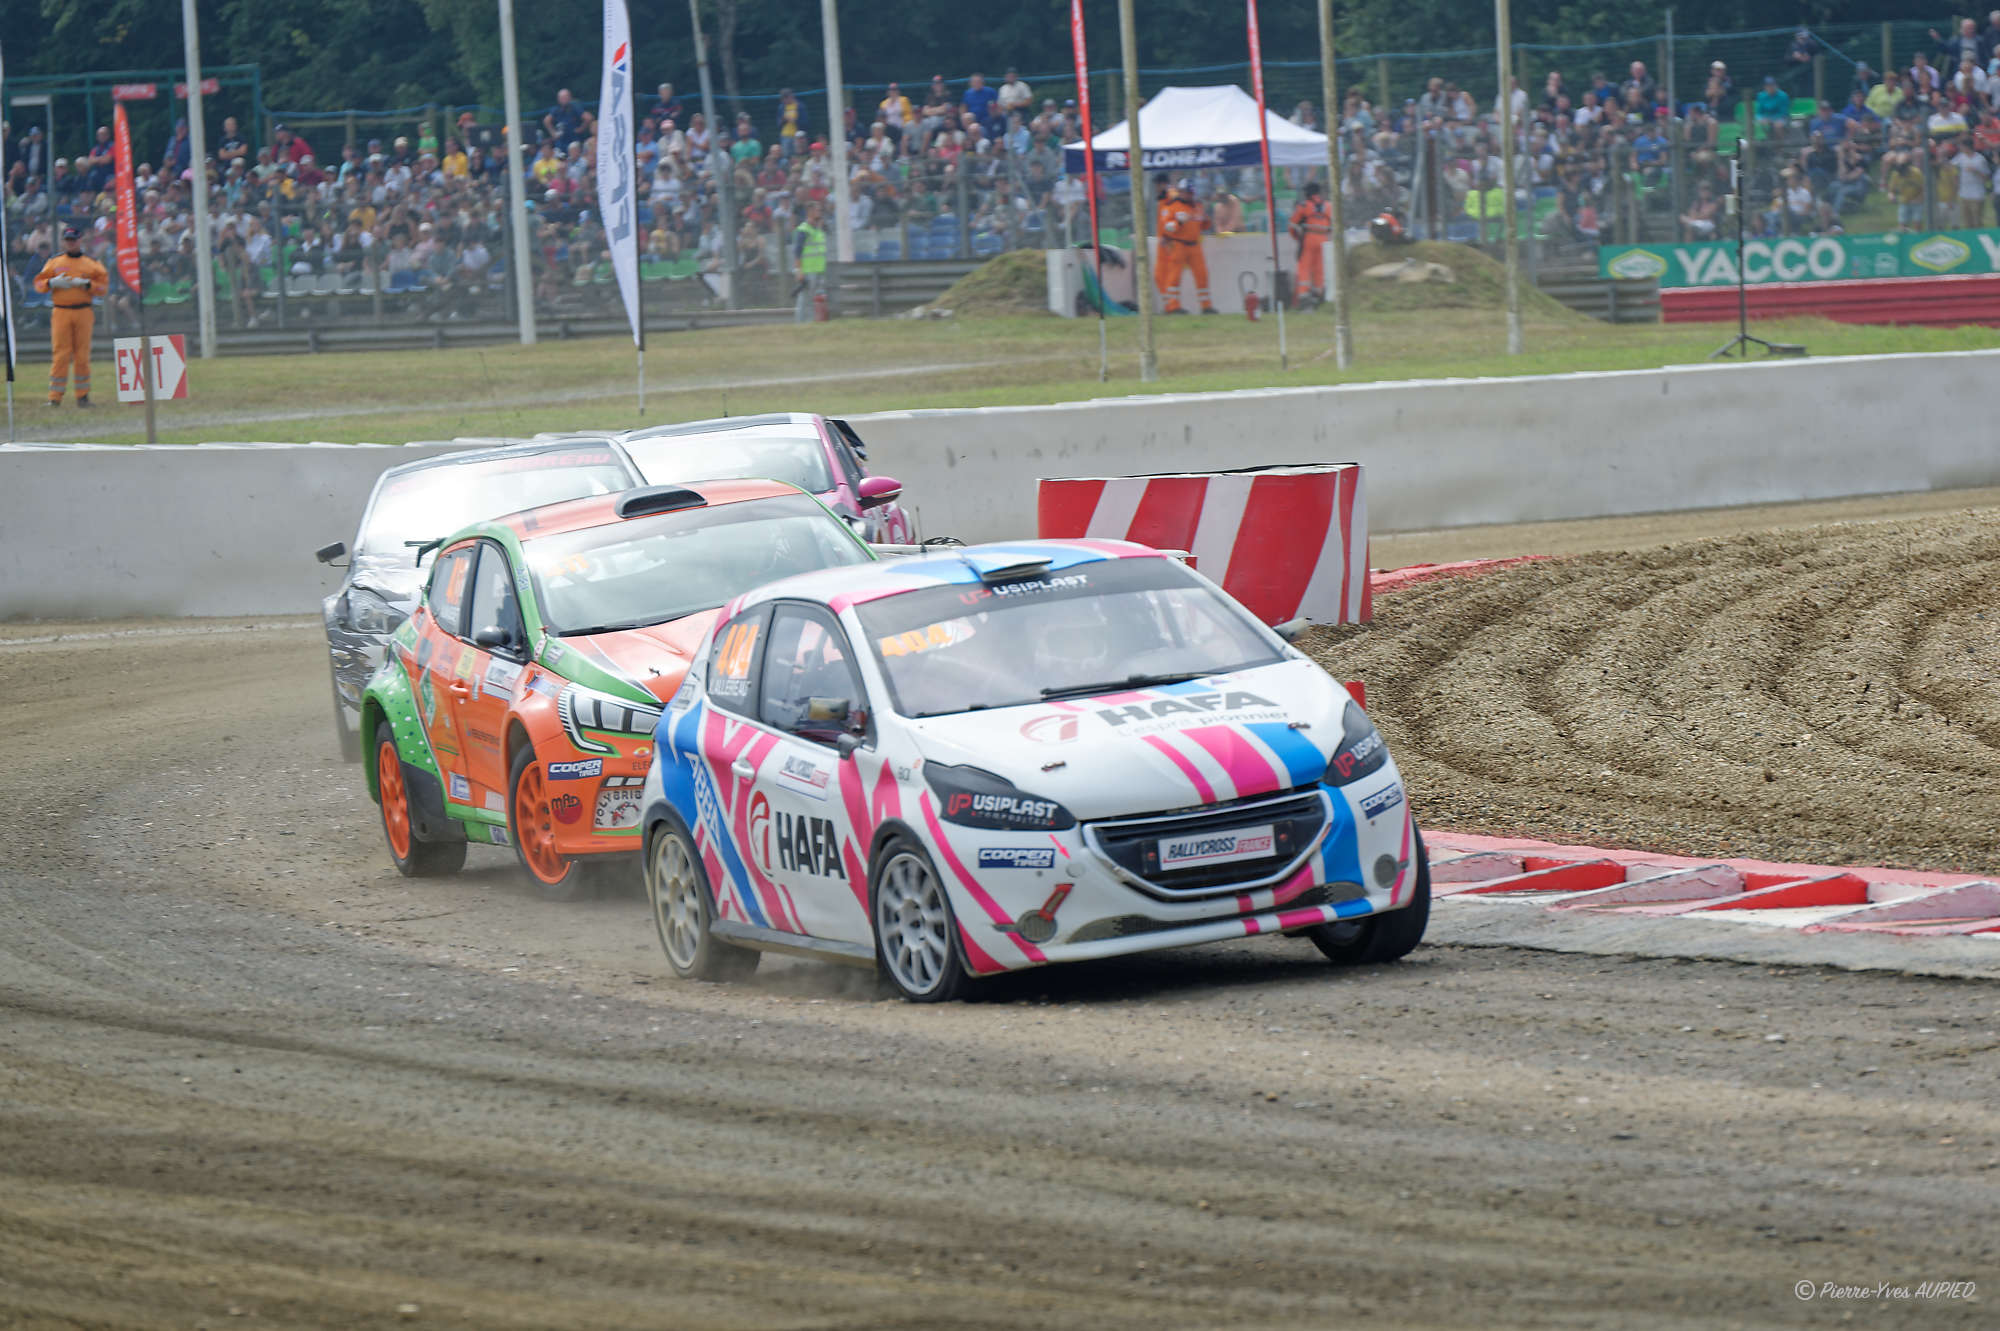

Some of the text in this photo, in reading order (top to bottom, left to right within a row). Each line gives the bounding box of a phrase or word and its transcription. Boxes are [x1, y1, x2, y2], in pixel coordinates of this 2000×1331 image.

[1674, 239, 1845, 285] YACCO
[117, 346, 163, 391] EXT
[992, 574, 1088, 596] USIPLAST
[880, 623, 954, 657] 404
[1096, 690, 1281, 727] HAFA
[550, 759, 601, 773] COOPER
[972, 793, 1059, 819] USIPLAST
[775, 811, 846, 880] HAFA
[980, 849, 1054, 860] COOPER
[1167, 835, 1237, 859] RALLYCROSS
